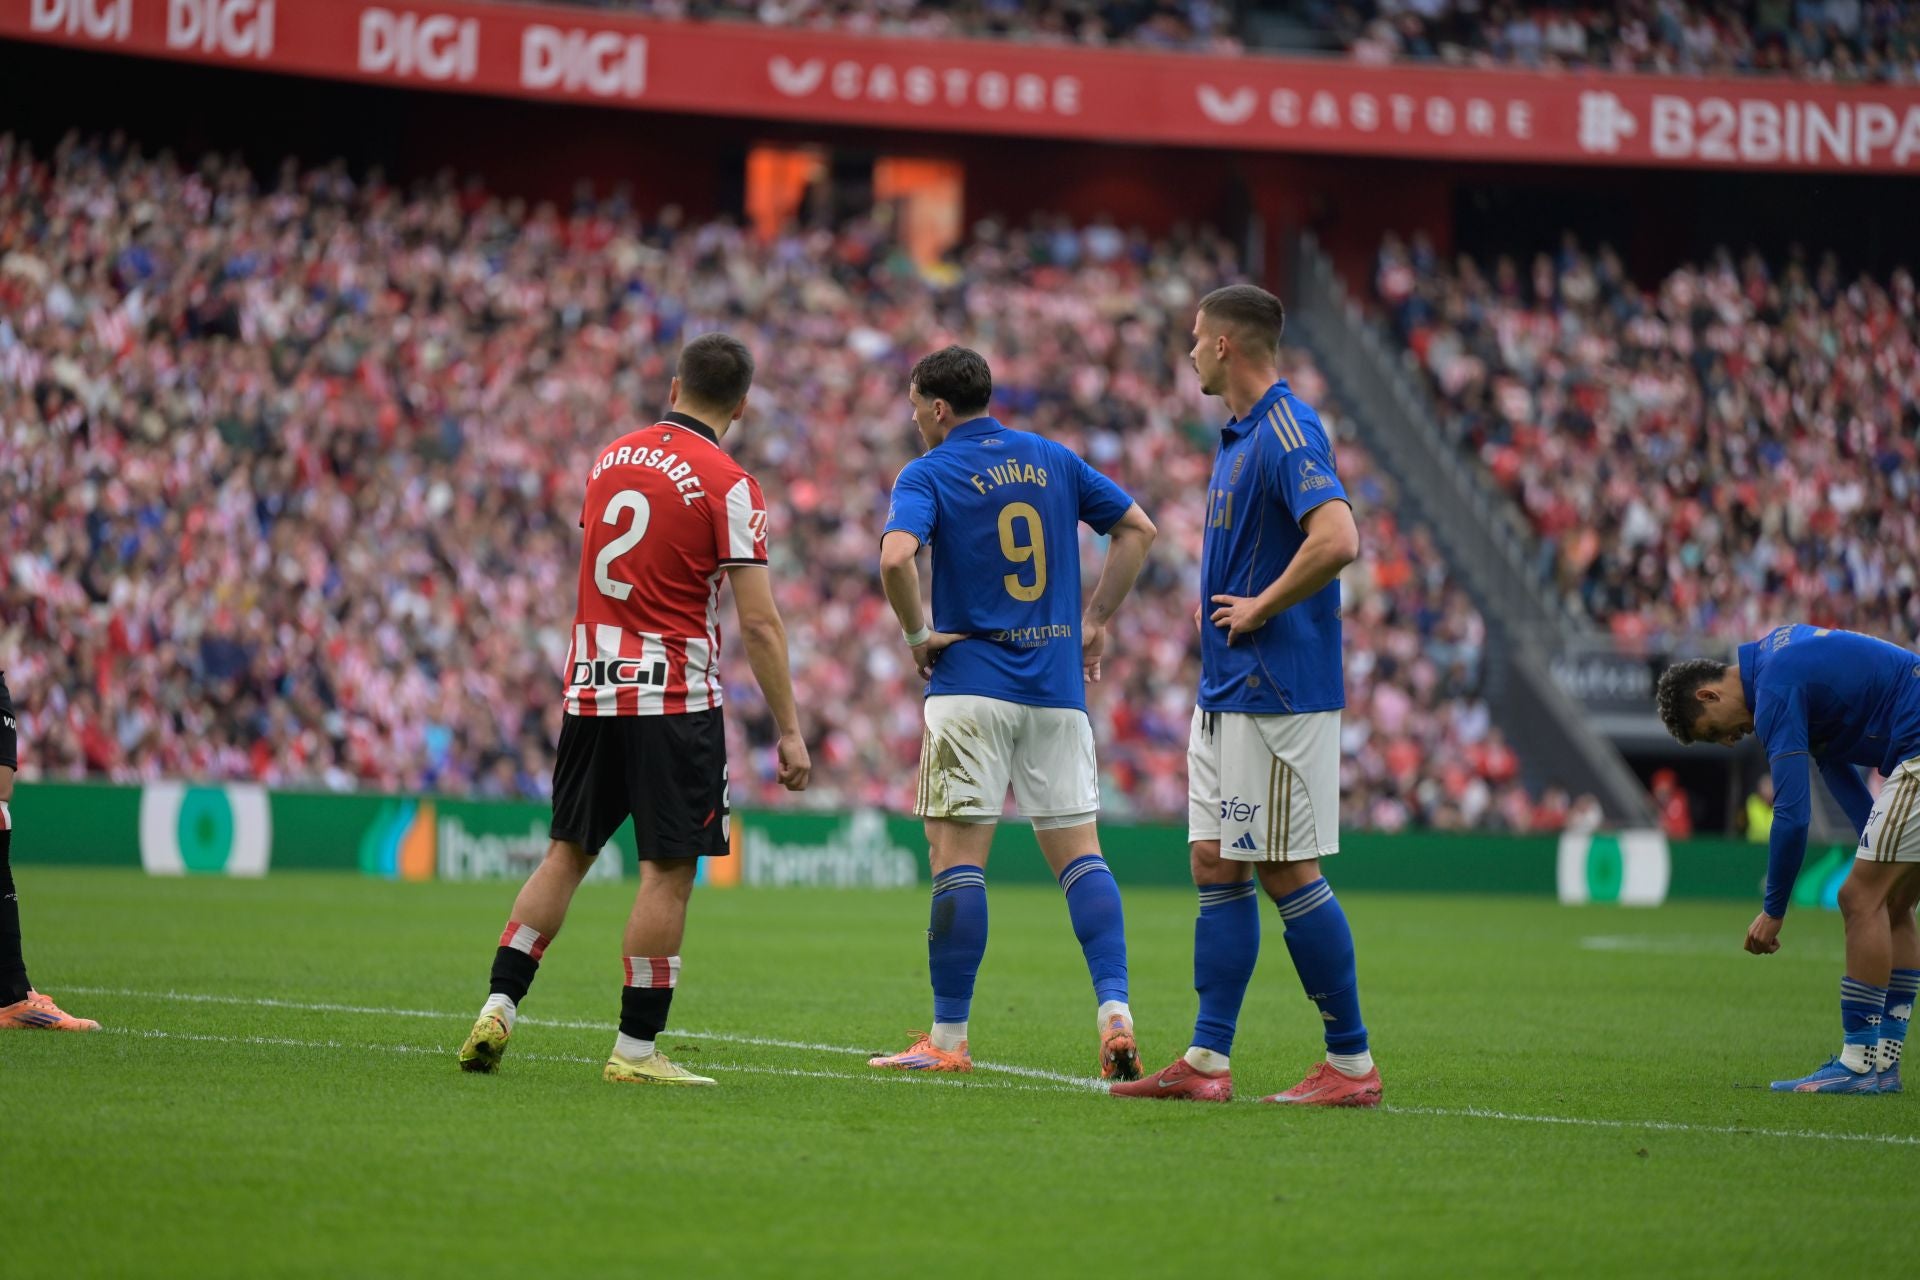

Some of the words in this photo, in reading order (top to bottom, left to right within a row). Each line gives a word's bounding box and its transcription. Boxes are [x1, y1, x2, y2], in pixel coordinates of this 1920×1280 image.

[166, 0, 275, 59] DIGI
[358, 6, 479, 82] DIGI
[520, 23, 646, 98] DIGI
[832, 60, 1081, 115] CASTORE
[1268, 87, 1534, 140] CASTORE
[592, 446, 705, 506] GOROSABEL
[594, 489, 650, 601] 2
[997, 501, 1047, 602] 9
[1010, 624, 1072, 642] HYUNDAI
[570, 659, 667, 687] DIGI
